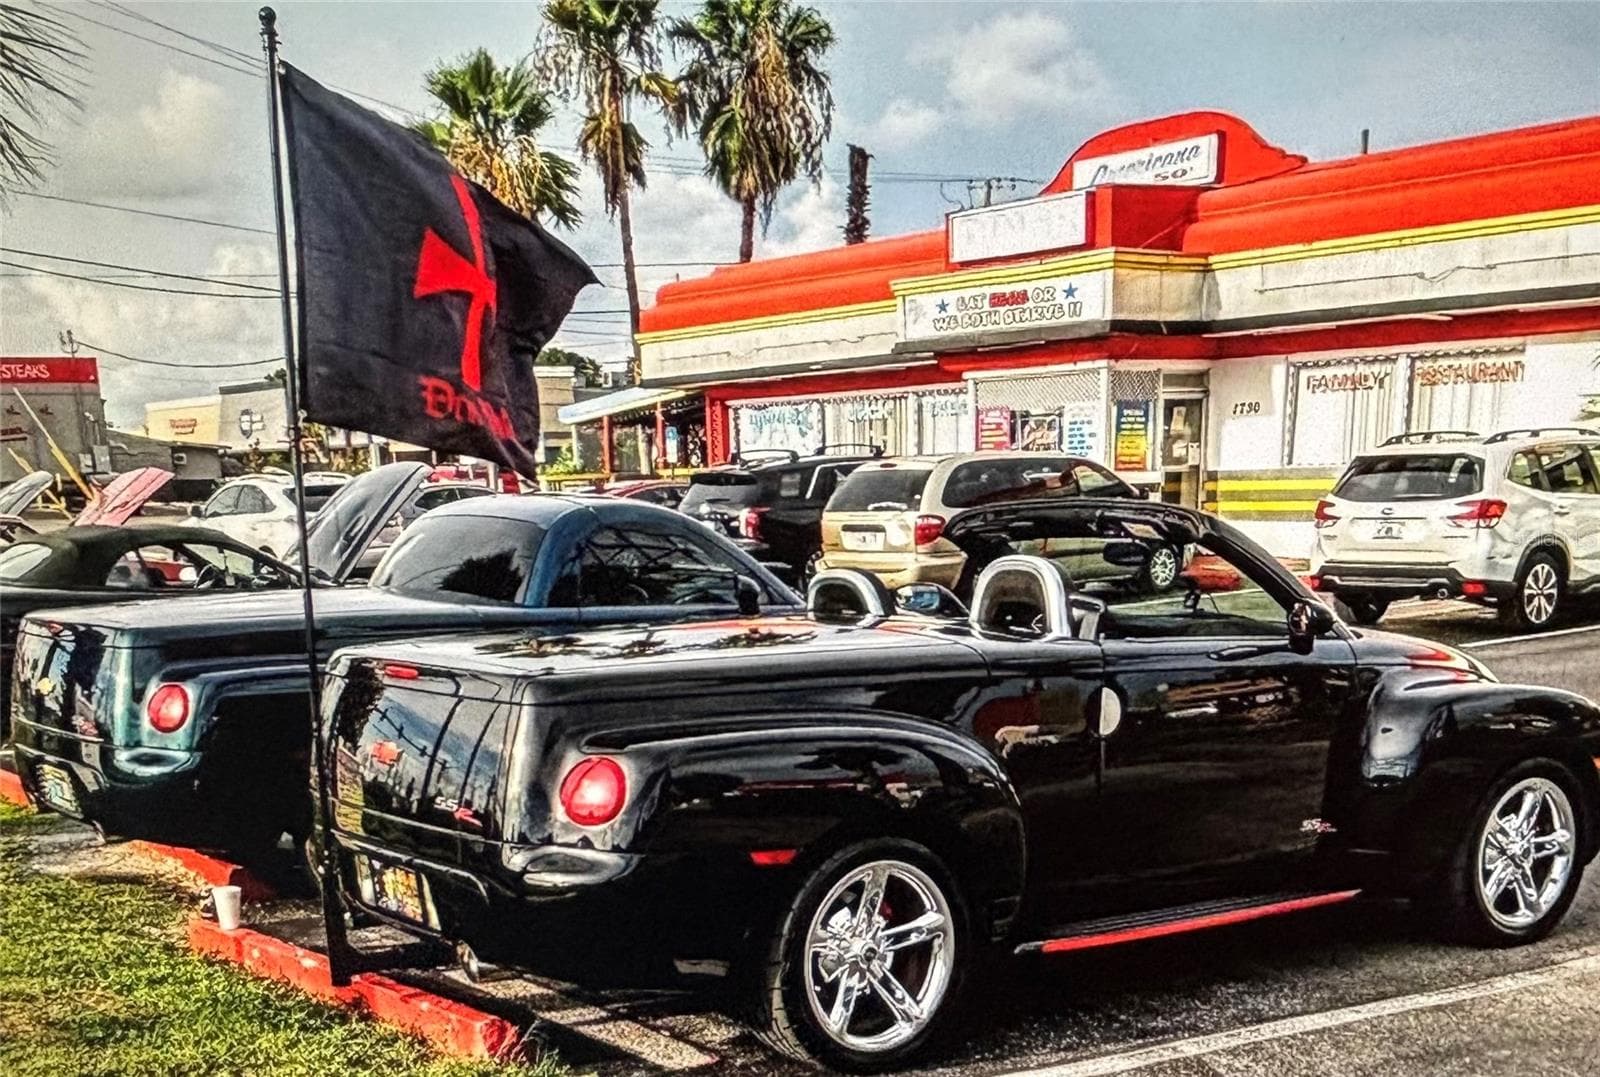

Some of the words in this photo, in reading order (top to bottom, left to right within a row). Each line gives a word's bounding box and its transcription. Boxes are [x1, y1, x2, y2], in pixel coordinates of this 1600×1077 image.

[1090, 145, 1201, 186] Aicana
[956, 293, 987, 313] EAT
[1031, 286, 1057, 304] OR
[933, 314, 960, 332] WE
[960, 310, 1001, 329] BOTH
[1003, 303, 1066, 325] STARVE
[1306, 371, 1391, 394] FAMILY
[1416, 361, 1525, 386] RESTAURANT
